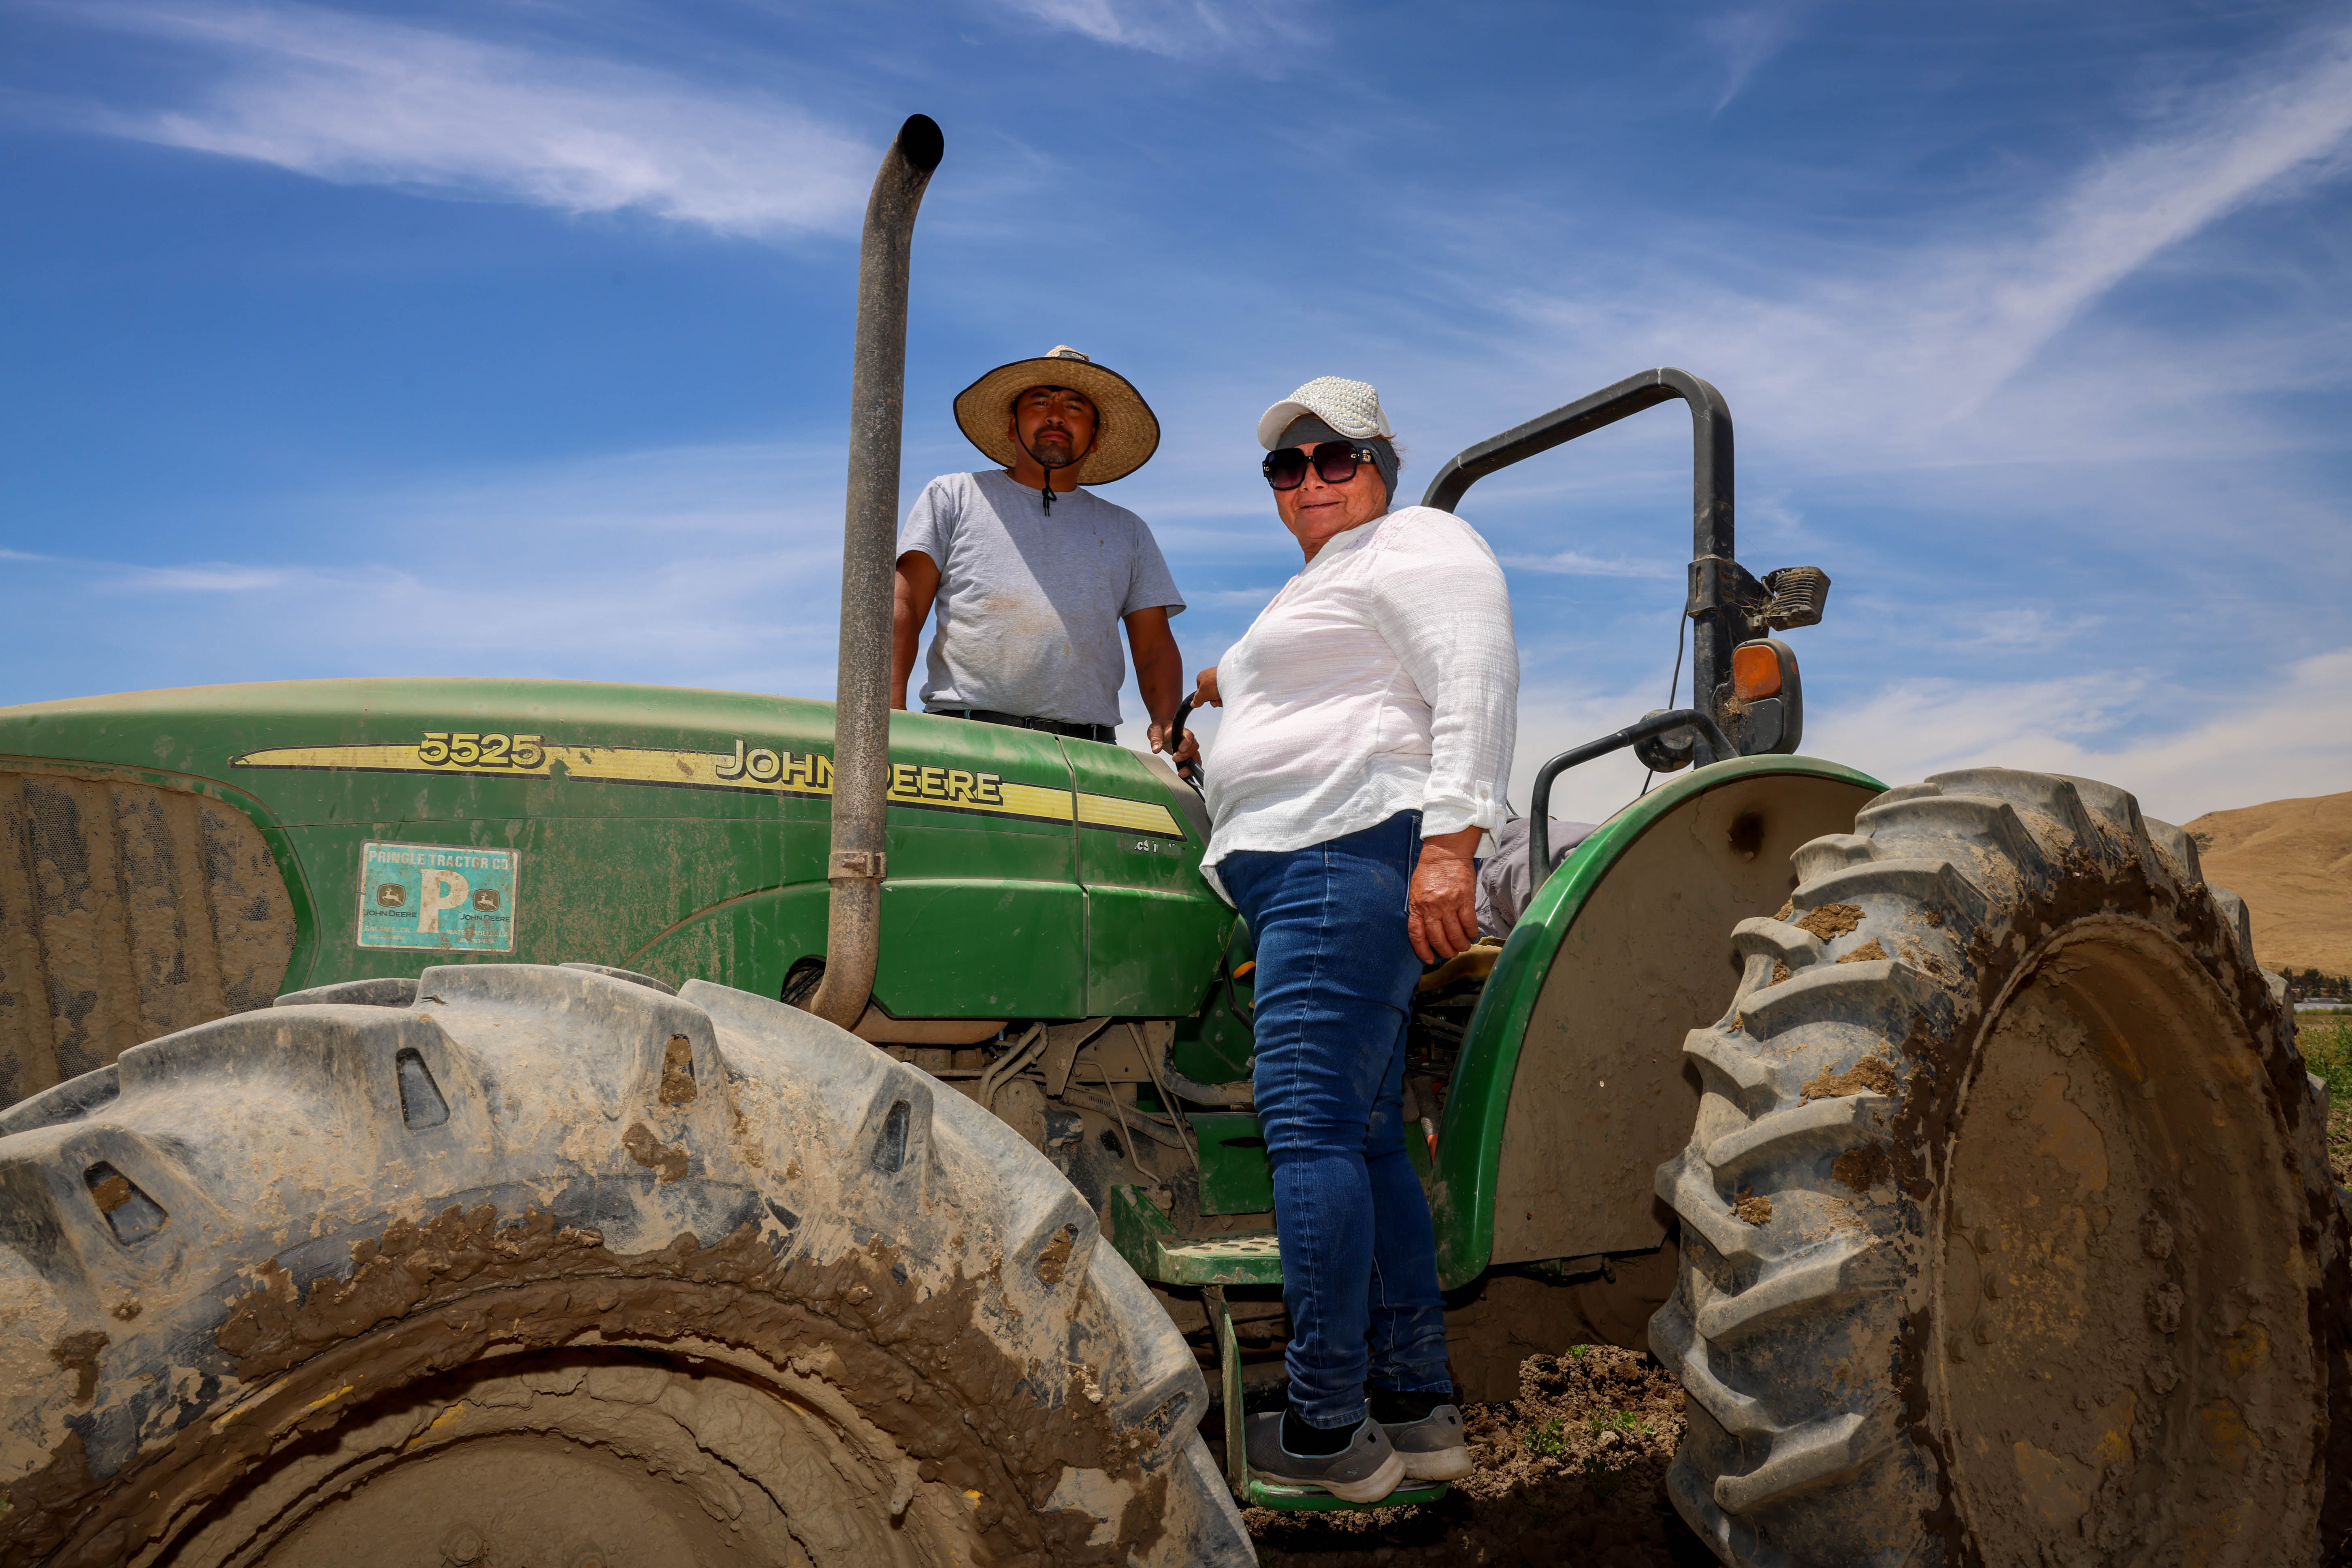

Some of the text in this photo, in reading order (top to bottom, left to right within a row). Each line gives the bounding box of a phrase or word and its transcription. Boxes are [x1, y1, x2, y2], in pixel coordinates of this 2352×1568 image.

[419, 732, 544, 768] 5525
[887, 763, 1002, 804] EERE
[369, 850, 425, 865] PRINGLE
[429, 854, 489, 869] TRACTOR
[416, 868, 469, 933] P
